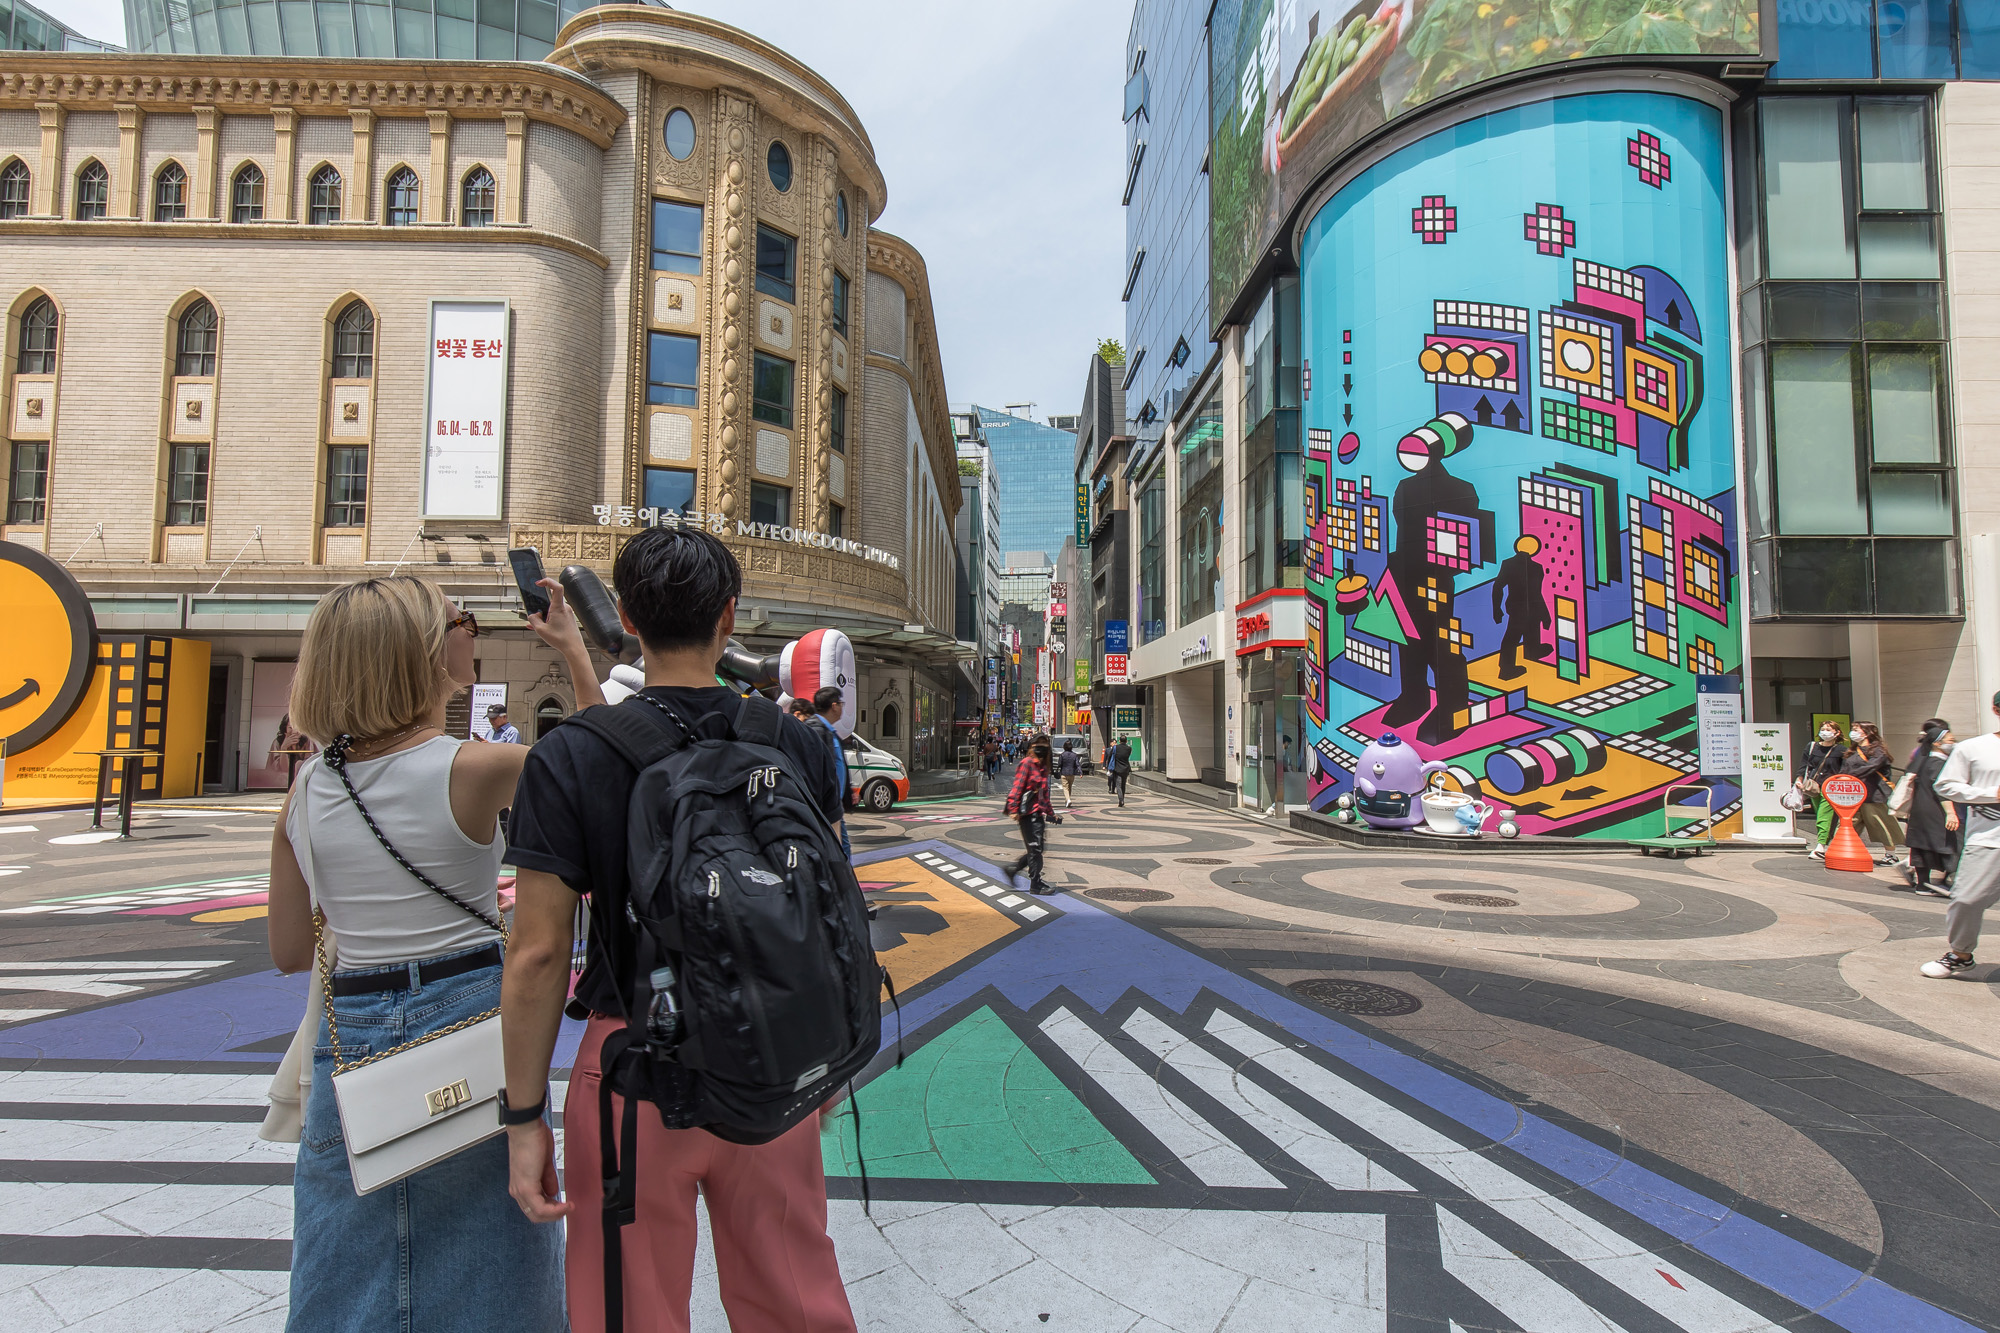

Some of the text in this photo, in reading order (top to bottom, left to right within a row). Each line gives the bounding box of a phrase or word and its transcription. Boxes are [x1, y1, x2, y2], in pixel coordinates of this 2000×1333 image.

[436, 338, 503, 358] 벚꽃 동산
[437, 420, 448, 436] 05.
[469, 420, 481, 436] 05.
[482, 420, 494, 436] 28.
[1078, 486, 1088, 516] 티안나
[592, 504, 728, 534] 명동예술극장
[737, 519, 863, 558] MYEONGDONG
[1763, 782, 1775, 790] 7F
